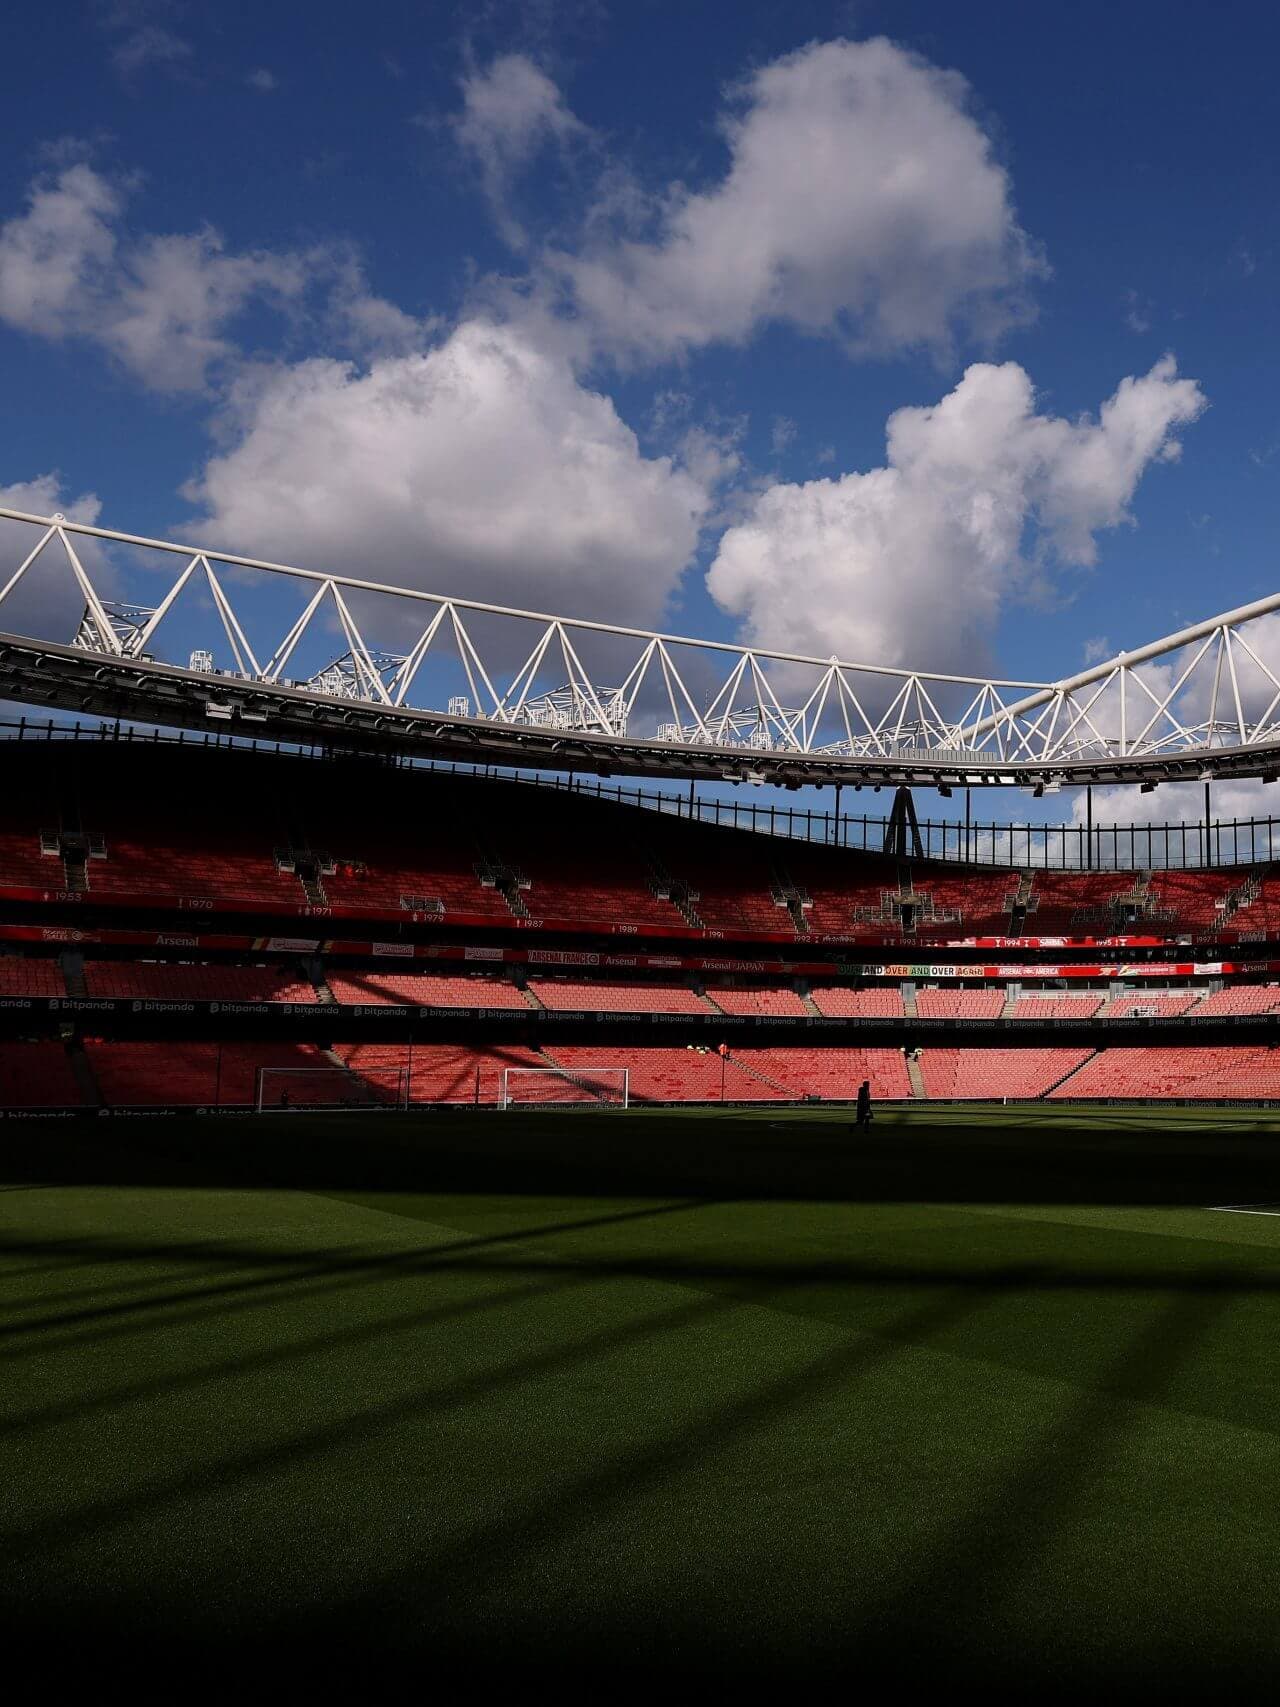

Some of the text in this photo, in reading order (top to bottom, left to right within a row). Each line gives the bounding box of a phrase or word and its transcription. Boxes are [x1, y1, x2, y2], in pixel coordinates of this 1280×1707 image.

[56, 891, 82, 901] 1953
[189, 900, 213, 909] 1970
[312, 907, 332, 916] 1971
[424, 914, 444, 922] 1979
[620, 925, 638, 934] 1989
[156, 934, 200, 947] Arsenal
[532, 950, 561, 962] ARSENAL
[606, 957, 637, 966] Arsenal
[702, 961, 731, 970] Arsenal
[864, 966, 884, 975] AND
[886, 966, 908, 975] OVER
[911, 967, 930, 976] AND
[932, 967, 954, 976] OVER
[999, 967, 1059, 975] ARSENAL AMERICA
[1242, 963, 1268, 973] Arsenal
[62, 1000, 116, 1011] bitpanda
[145, 1002, 195, 1013] bitpanda
[221, 1004, 268, 1015] bitpanda
[294, 1005, 340, 1016] bitpanda
[364, 1007, 408, 1017] bitpanda
[430, 1008, 471, 1018] bitpanda
[488, 1009, 527, 1019] bitpanda
[605, 1013, 641, 1022] bitpanda
[763, 1017, 797, 1026] bitpanda
